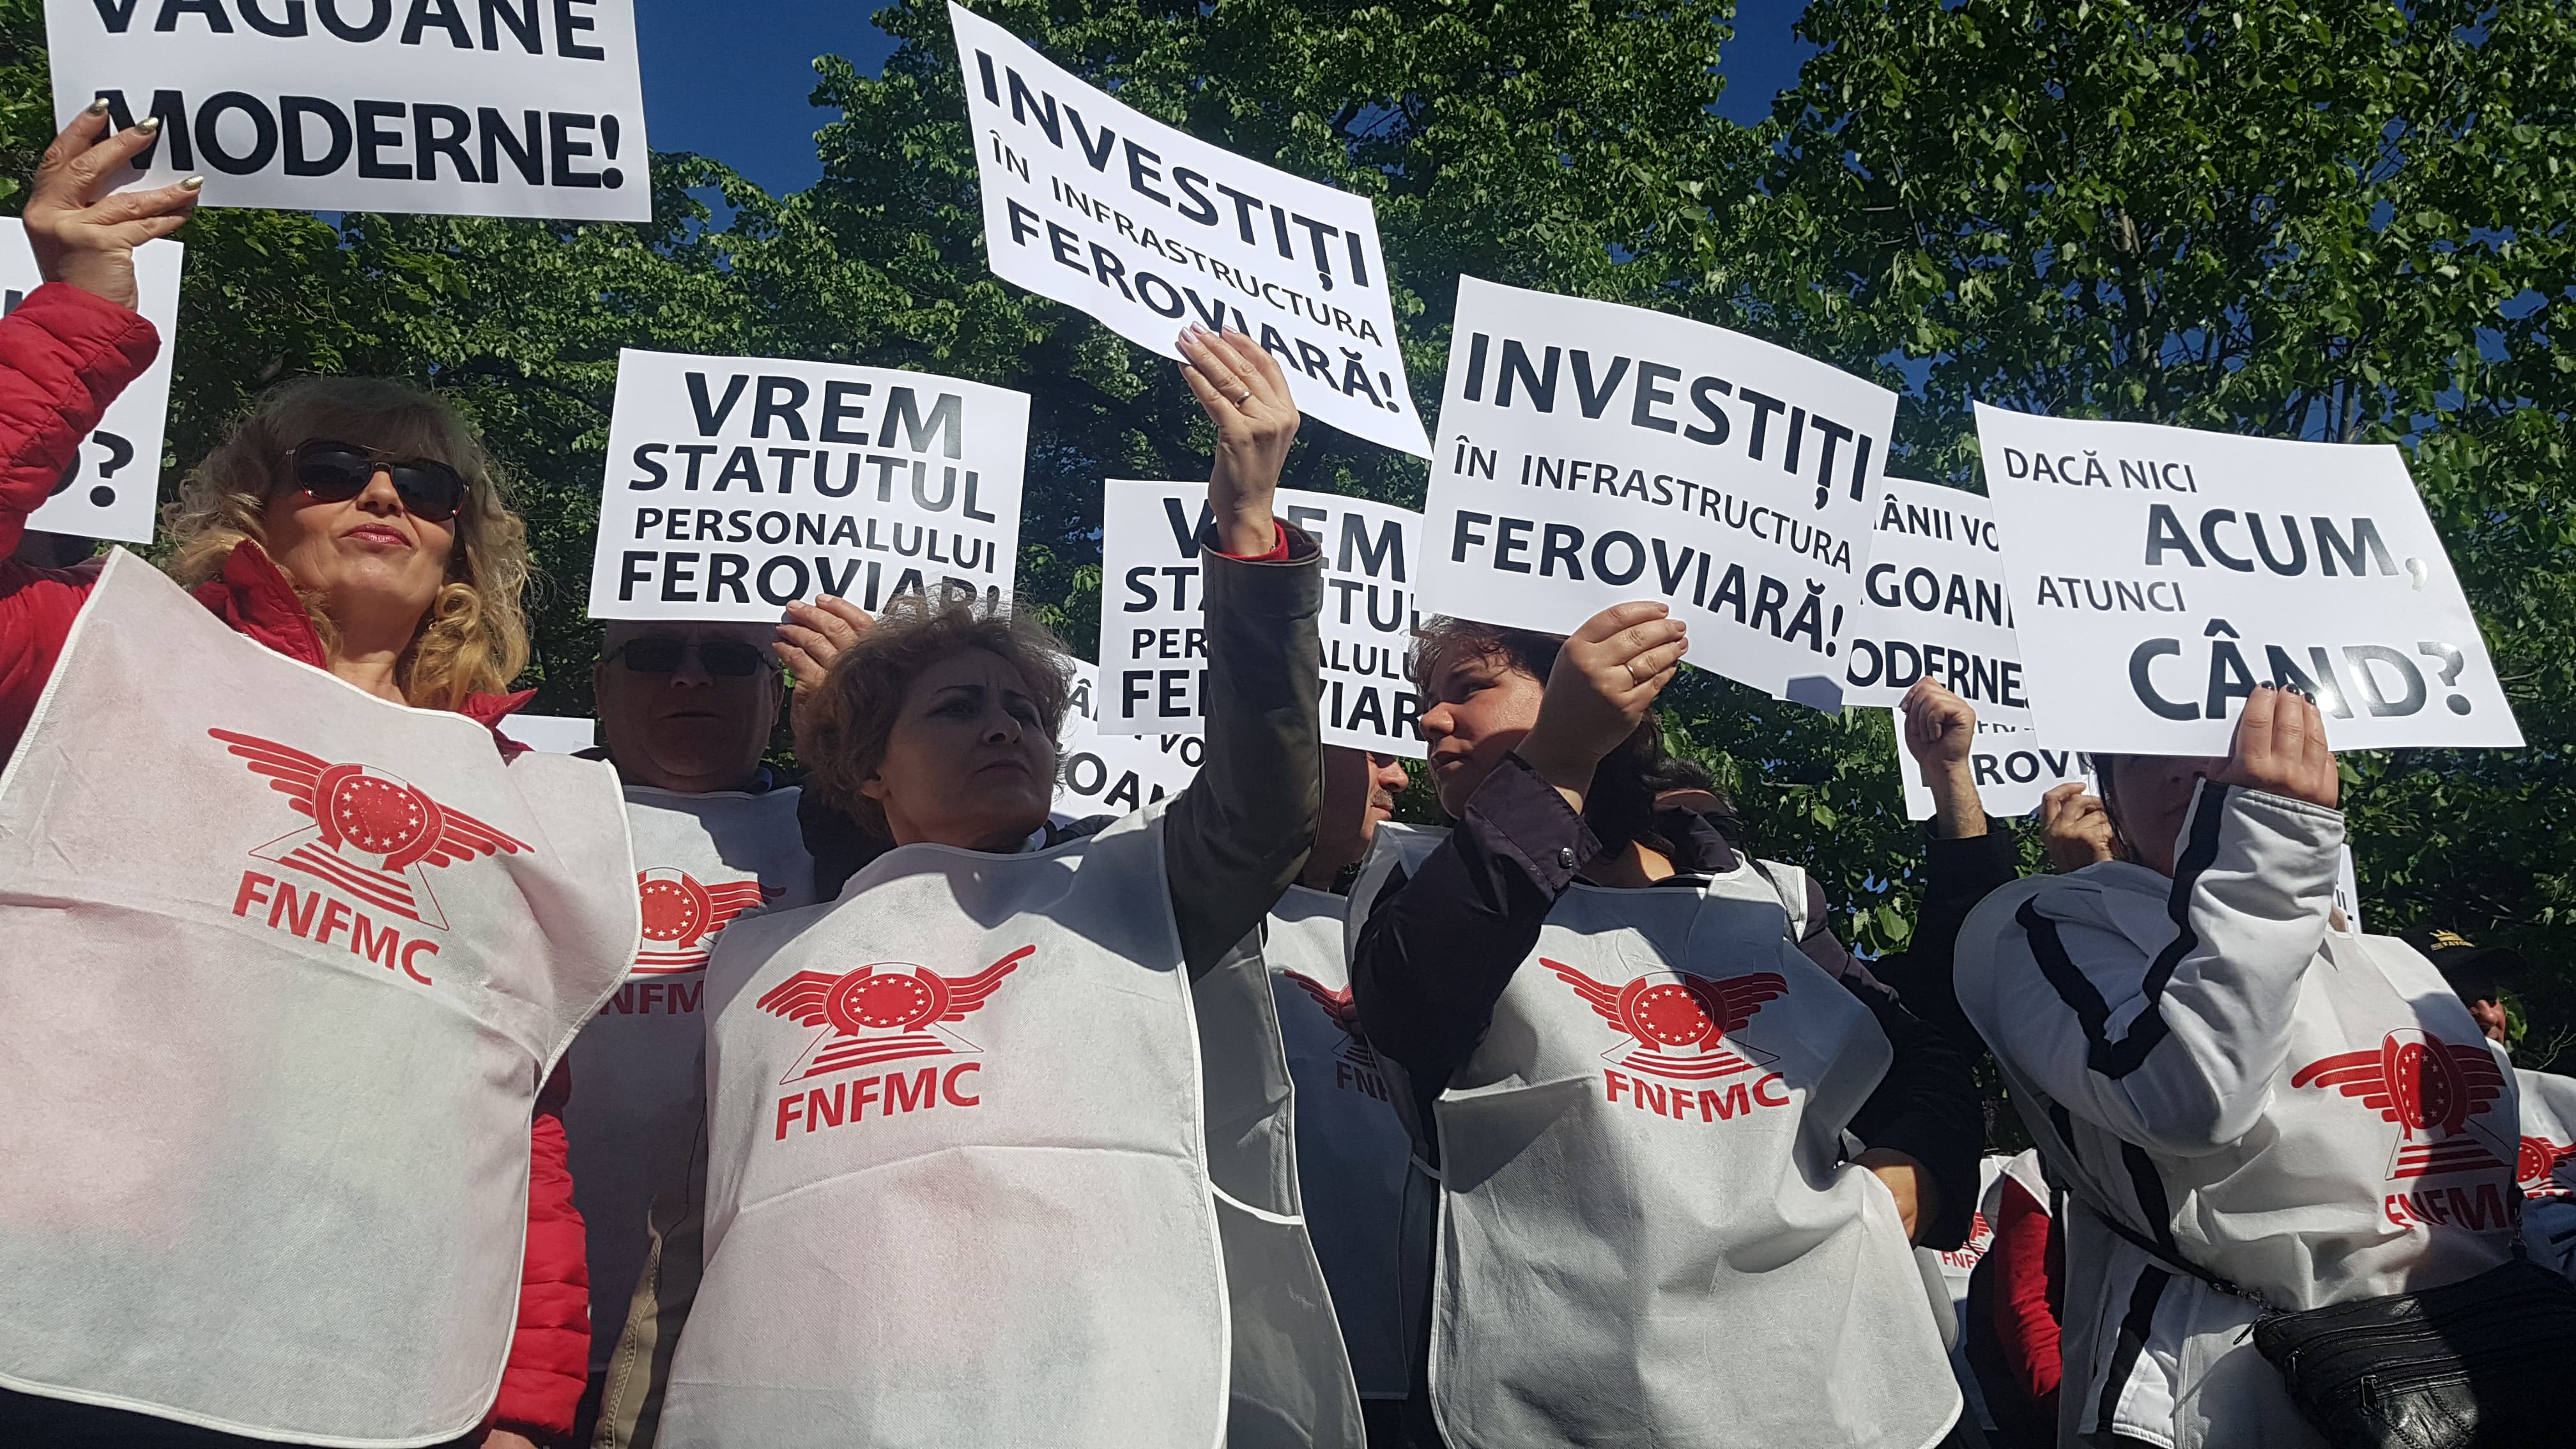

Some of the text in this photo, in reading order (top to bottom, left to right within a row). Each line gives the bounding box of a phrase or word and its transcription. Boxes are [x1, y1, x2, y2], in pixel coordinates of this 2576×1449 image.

[95, 89, 624, 189] MODERNE!
[975, 48, 1368, 291] INVESTIȚI
[989, 130, 1383, 348] ÎN INFRASTRUCTURA
[1006, 197, 1400, 413] FEROVIARĂ!
[685, 372, 962, 459] VREM
[1463, 333, 1873, 510] INVESTIȚI
[628, 443, 995, 523] STATUTUL
[1454, 434, 1852, 574] ÎN INFRASTRUCTURA
[2004, 447, 2197, 493] DACĂ NICI
[635, 507, 995, 573] PERSONALULUI
[1452, 510, 1844, 657] FEROVIARĂ!
[2145, 503, 2427, 591] ACUM,
[2038, 576, 2186, 611] ATUNCI
[2129, 618, 2472, 721] CÂND?
[232, 870, 440, 986] FNFMC
[600, 980, 703, 1015] NFM
[776, 1062, 981, 1141] FNFMC
[1604, 1068, 1790, 1123] FNFMC
